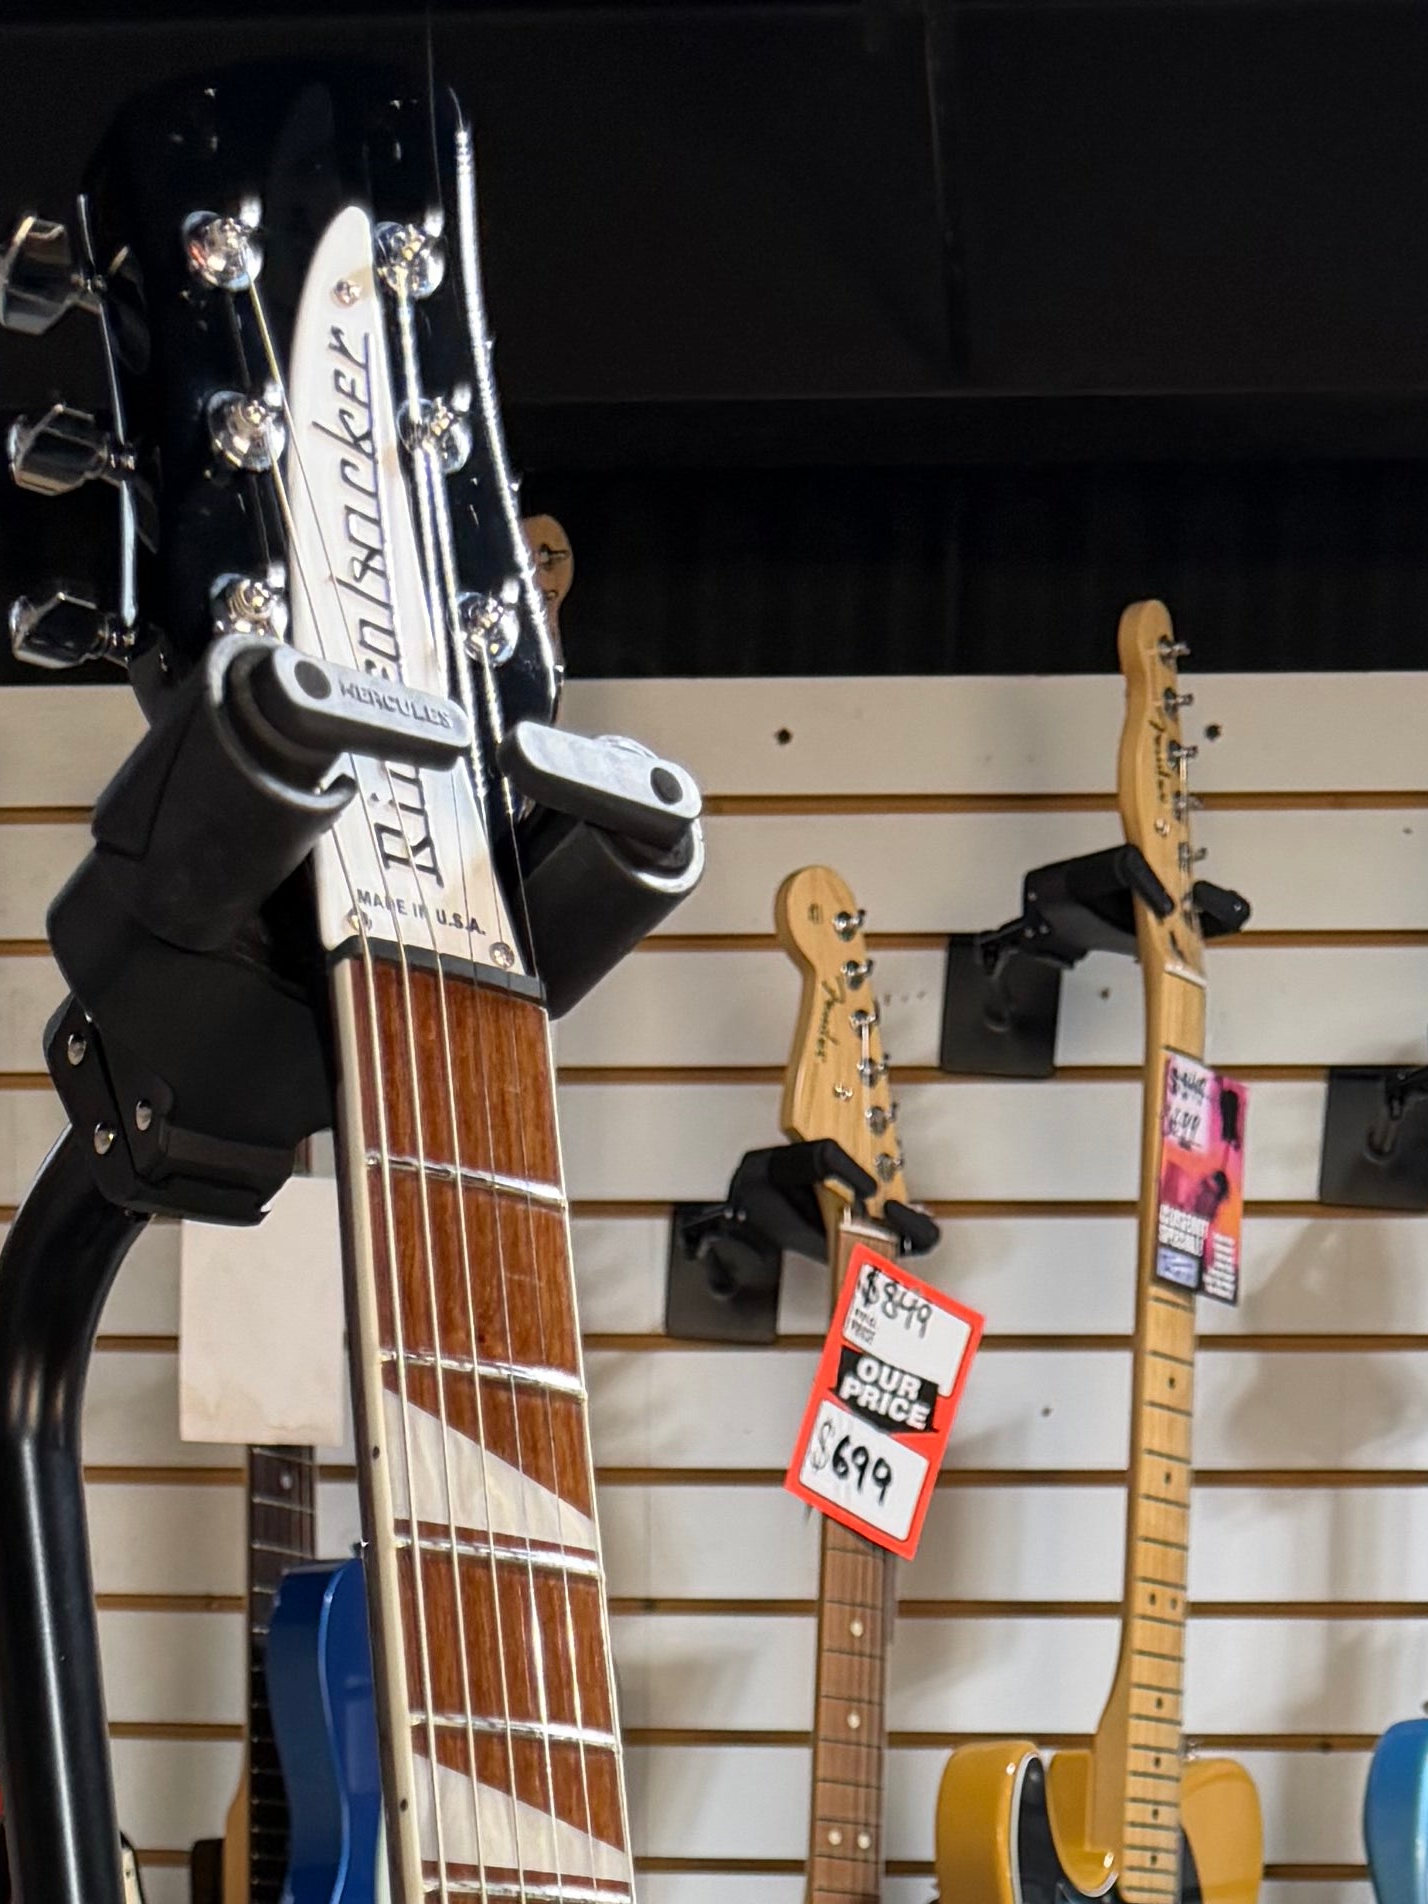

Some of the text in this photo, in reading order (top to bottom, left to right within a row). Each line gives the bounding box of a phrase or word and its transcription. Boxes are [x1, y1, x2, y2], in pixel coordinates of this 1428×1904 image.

[339, 680, 452, 729] HERCULES
[838, 1372, 931, 1431] PRICE
[856, 1356, 922, 1401] OUR
[810, 1417, 895, 1506] $699
